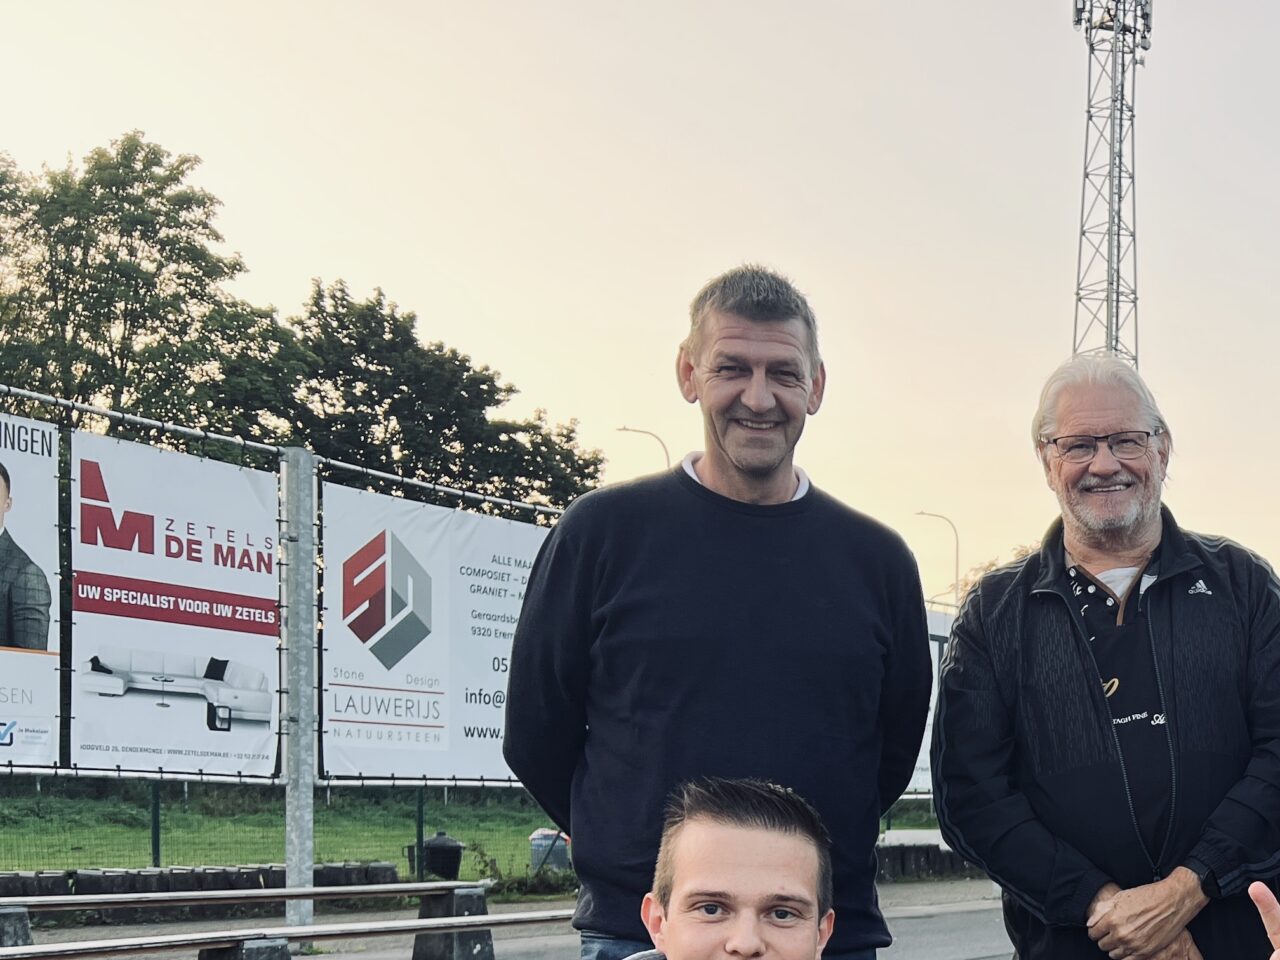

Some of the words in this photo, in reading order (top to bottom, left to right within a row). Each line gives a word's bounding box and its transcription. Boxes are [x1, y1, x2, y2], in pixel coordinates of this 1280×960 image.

[165, 518, 273, 549] ZETELS
[165, 534, 203, 563] DE
[213, 543, 273, 574] MAN
[491, 554, 512, 566] ALLE
[460, 566, 511, 582] COMPOSIET
[470, 584, 508, 598] GRANIET
[78, 584, 101, 600] UW
[103, 587, 175, 611] SPECIALIST
[178, 598, 209, 614] VOOR
[213, 603, 232, 618] UW
[235, 606, 275, 624] ZETELS
[471, 626, 492, 637] 9320
[492, 656, 508, 672] 05
[333, 667, 365, 681] Stone
[406, 674, 440, 688] Design
[334, 693, 440, 719] LAUWERIJS
[465, 688, 505, 708] info@
[333, 727, 440, 743] NATUURSTEEN
[464, 726, 503, 739] www.
